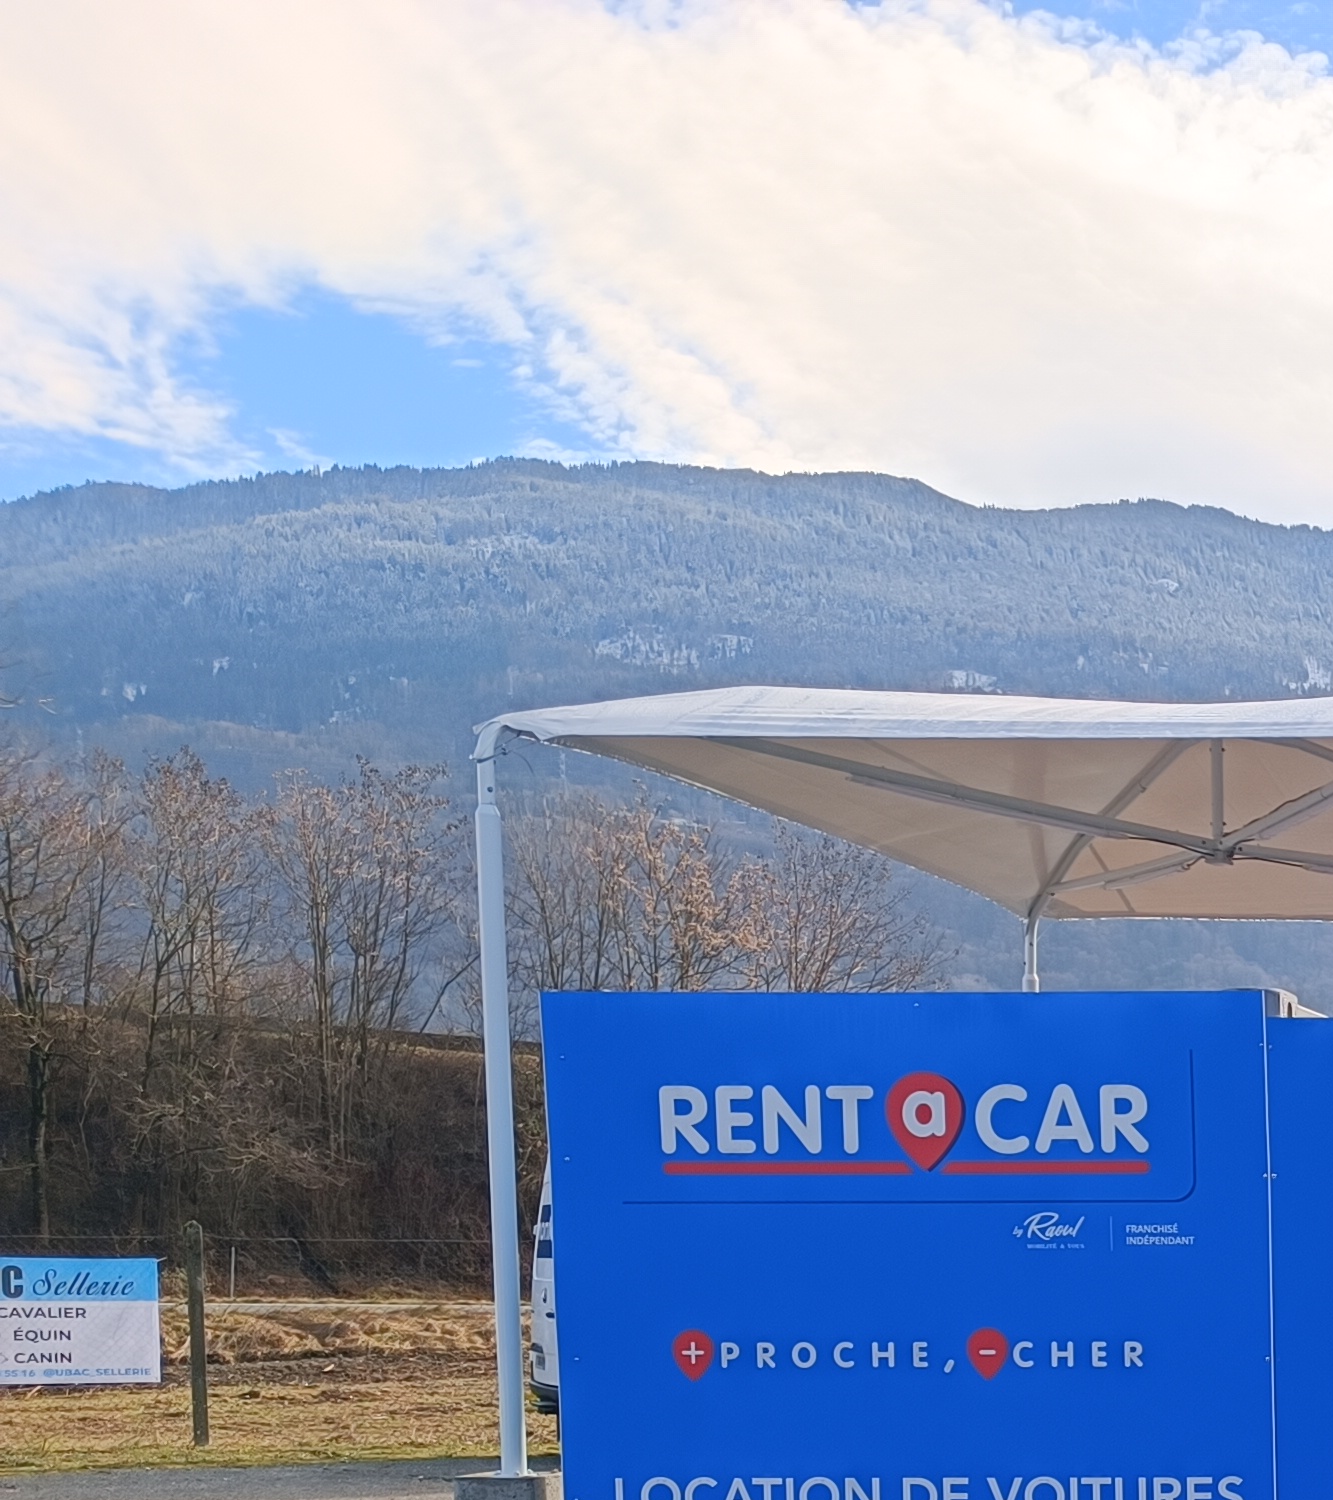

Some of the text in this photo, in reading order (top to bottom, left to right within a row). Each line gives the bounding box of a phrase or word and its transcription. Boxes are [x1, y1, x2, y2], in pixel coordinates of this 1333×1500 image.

[658, 1084, 874, 1155] RENT
[974, 1083, 1150, 1155] CAR
[1024, 1211, 1085, 1241] Raoul
[1125, 1222, 1179, 1234] FRANCHISÉ
[1125, 1235, 1195, 1245] INDÉPENDANT
[32, 1268, 135, 1297] Sellerie
[13, 1327, 72, 1343] ÉQUIN
[14, 1352, 72, 1364] CANIN
